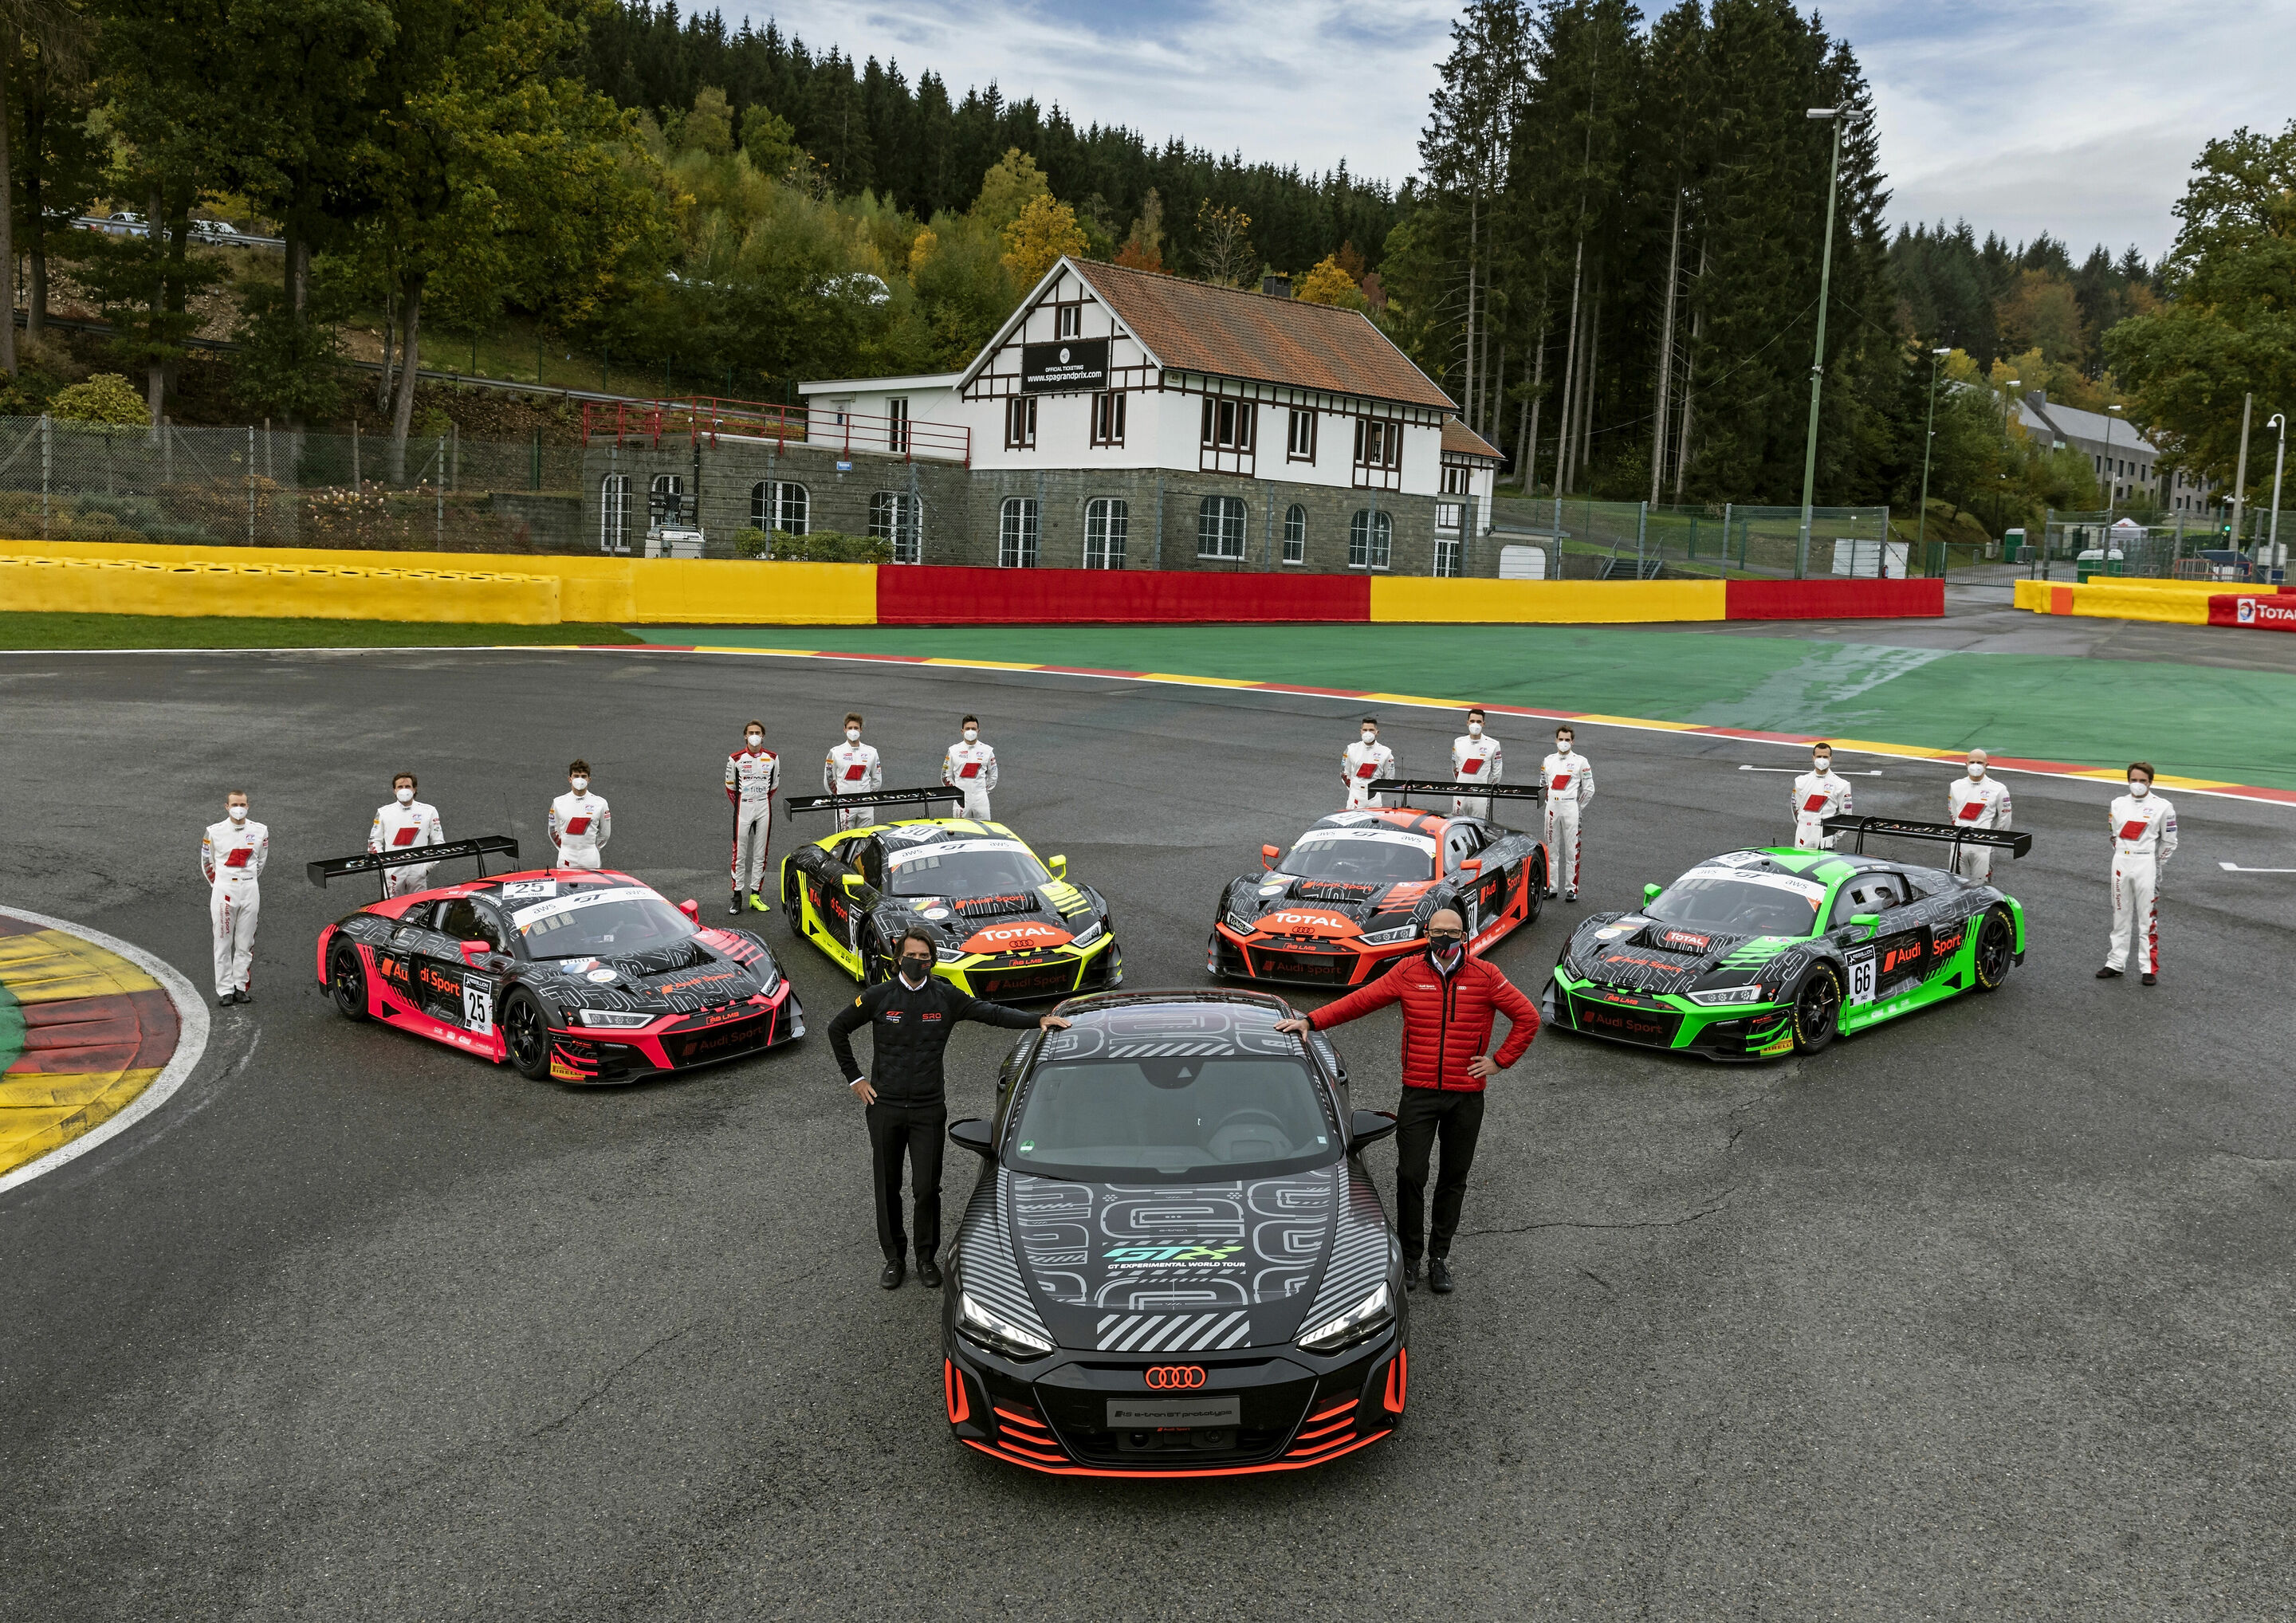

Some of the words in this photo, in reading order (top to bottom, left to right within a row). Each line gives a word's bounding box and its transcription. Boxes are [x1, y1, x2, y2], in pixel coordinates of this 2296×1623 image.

[1027, 371, 1102, 382] www.spagrandprix.com
[2256, 604, 2296, 619] TOTA
[901, 827, 932, 836] 30
[1401, 835, 1421, 843] aws
[902, 848, 923, 858] aws
[515, 882, 545, 894] 25
[1343, 882, 1374, 892] Sport
[1785, 879, 1809, 890] aws
[997, 895, 1026, 904] Sport
[533, 904, 556, 915] aws
[1276, 913, 1343, 928] TOTAL
[979, 927, 1056, 941] TOTAL
[1670, 931, 1704, 945] TOTAL
[1897, 942, 1921, 964] Audi
[1933, 934, 1961, 955] Sport
[1276, 962, 1303, 973] Audi
[1308, 964, 1342, 975] Sport
[1622, 957, 1648, 965] Audi
[1649, 960, 1683, 973] Sport
[394, 964, 429, 983] Audi
[431, 972, 460, 996] Sport
[676, 978, 702, 988] Audi
[703, 973, 734, 983] Sport
[1002, 977, 1032, 988] Audi
[1036, 974, 1067, 987] Sport
[1854, 963, 1870, 995] 66
[1621, 996, 1638, 1005] LMS
[469, 992, 485, 1024] 25
[722, 1012, 739, 1020] LMS
[1596, 1013, 1623, 1028] Audi
[1626, 1019, 1662, 1034] Sport
[699, 1038, 729, 1051] Audi
[731, 1026, 763, 1043] Sport
[1181, 1409, 1233, 1418] prototype
